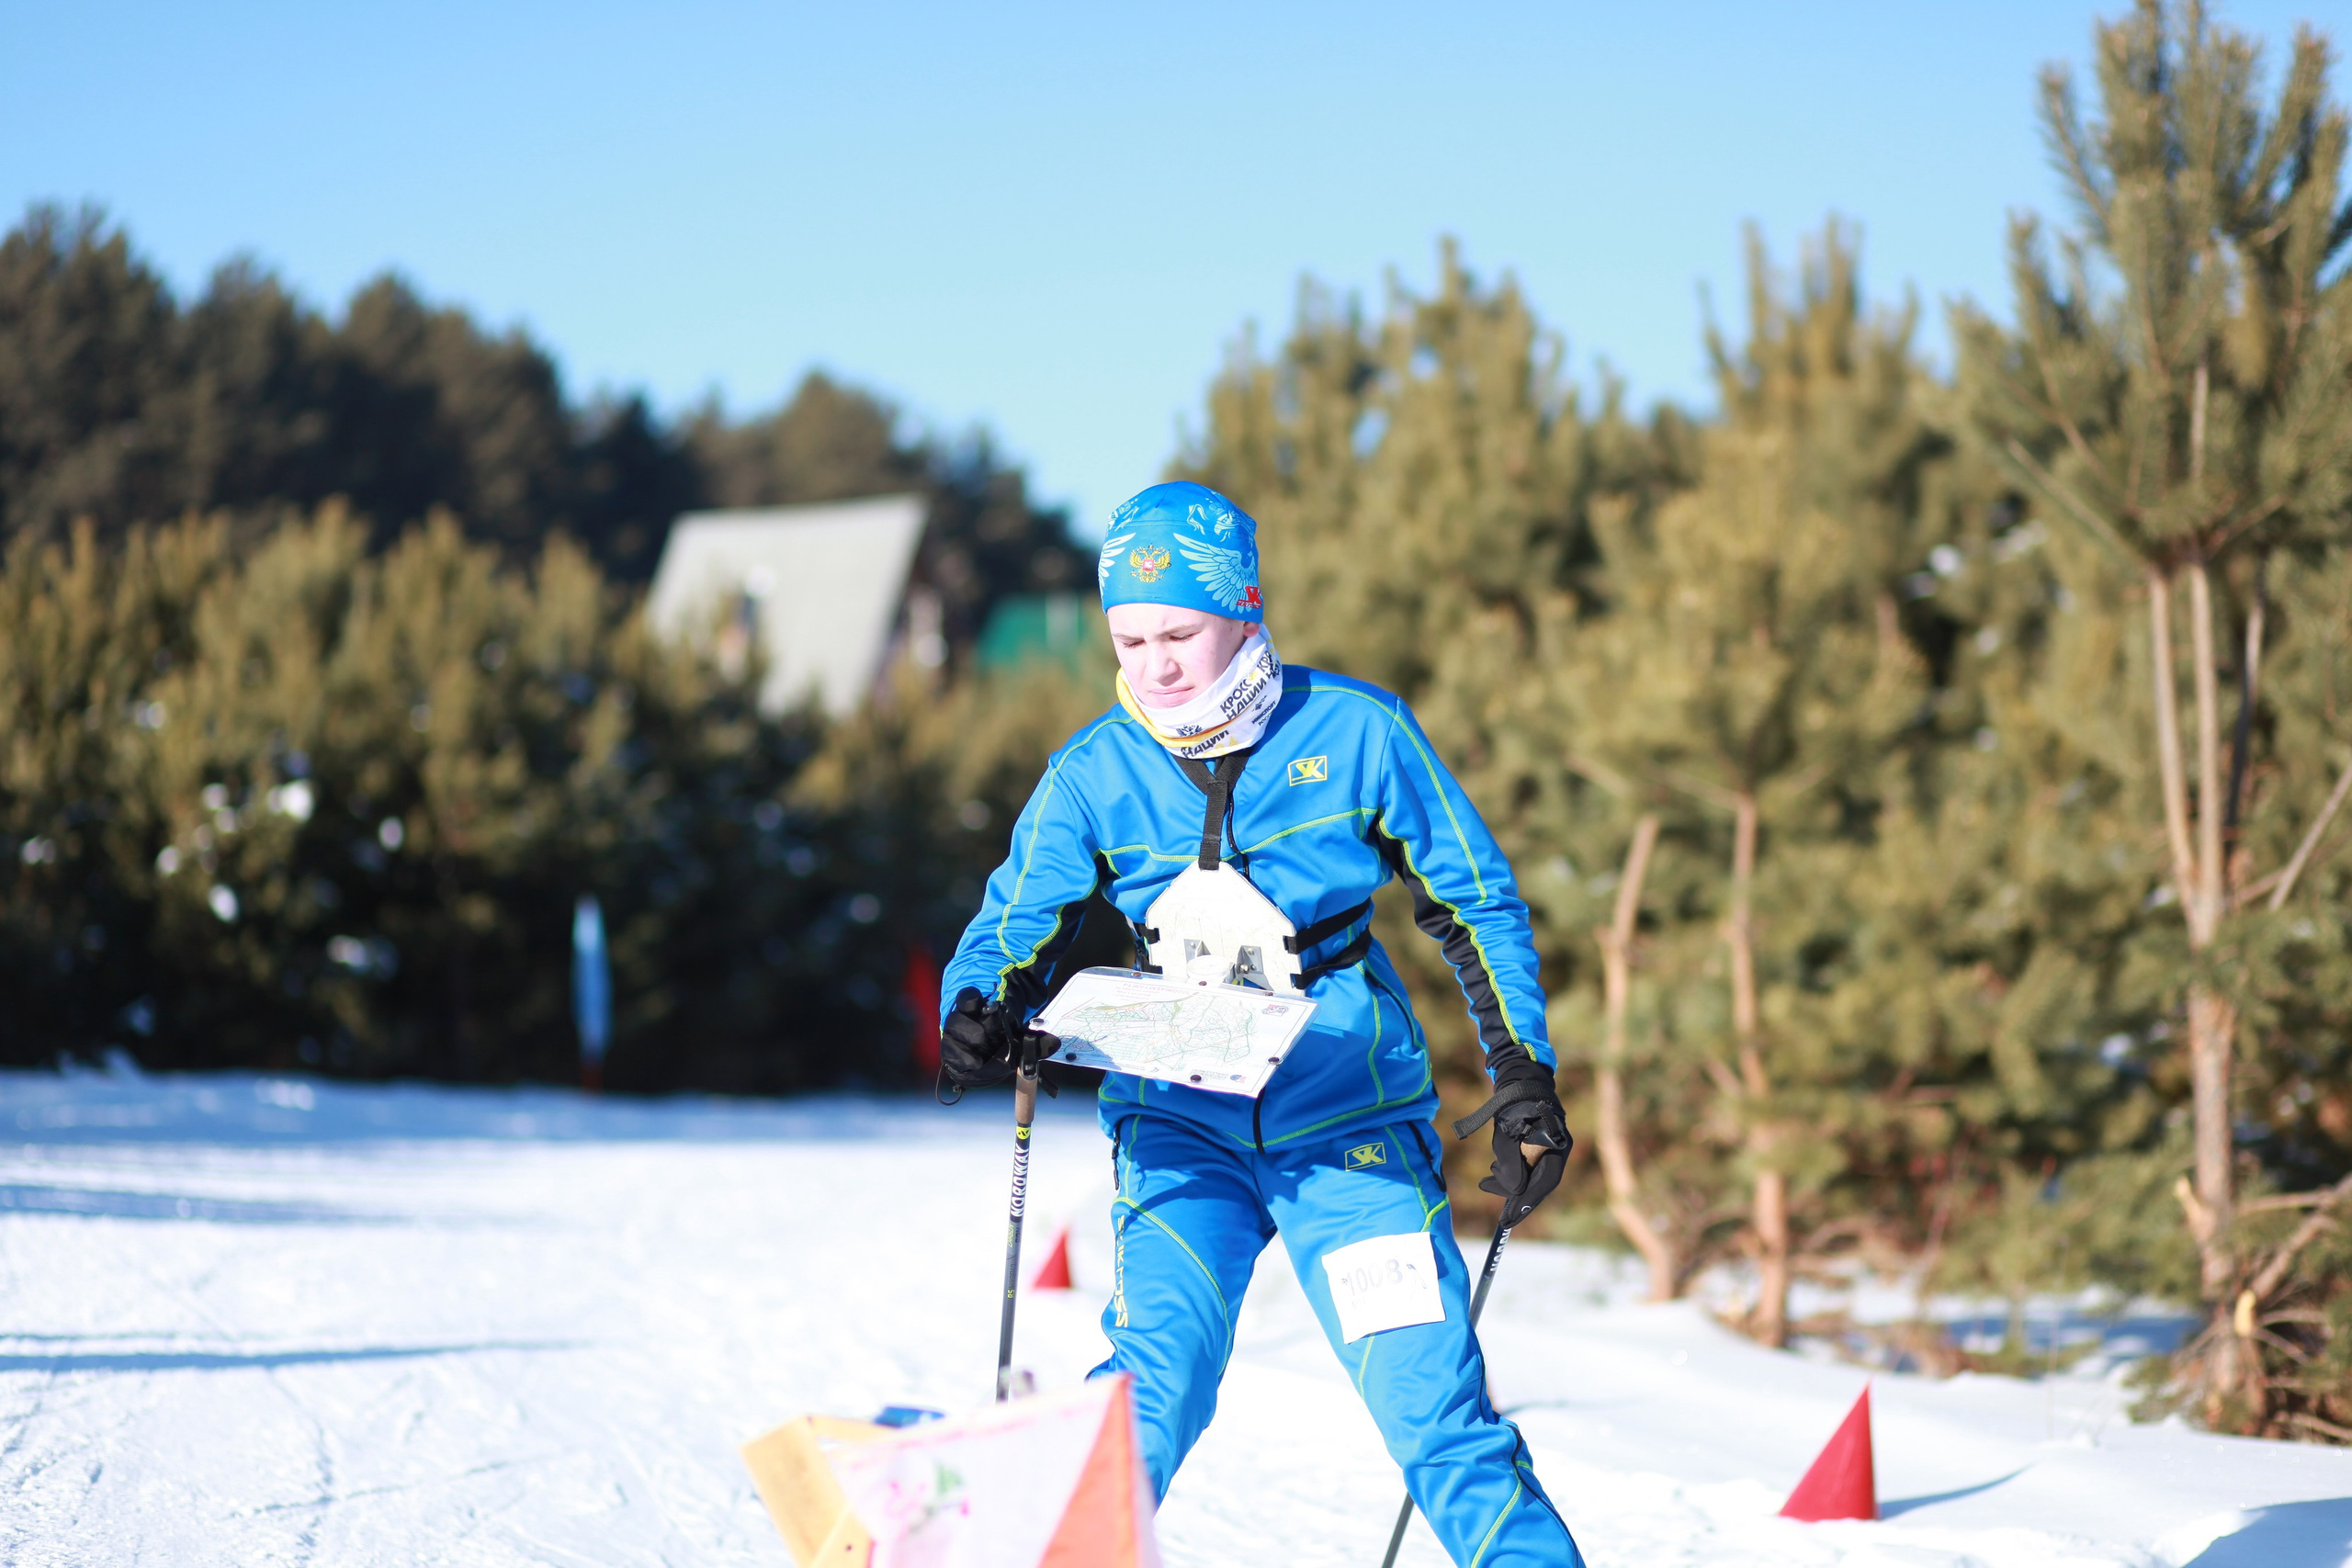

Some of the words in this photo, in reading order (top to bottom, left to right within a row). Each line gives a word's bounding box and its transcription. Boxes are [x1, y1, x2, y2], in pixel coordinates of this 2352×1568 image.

[1219, 679, 1252, 713] КРОСС
[1226, 677, 1267, 721] НАЦИИ
[1010, 1143, 1029, 1217] NORDWAY
